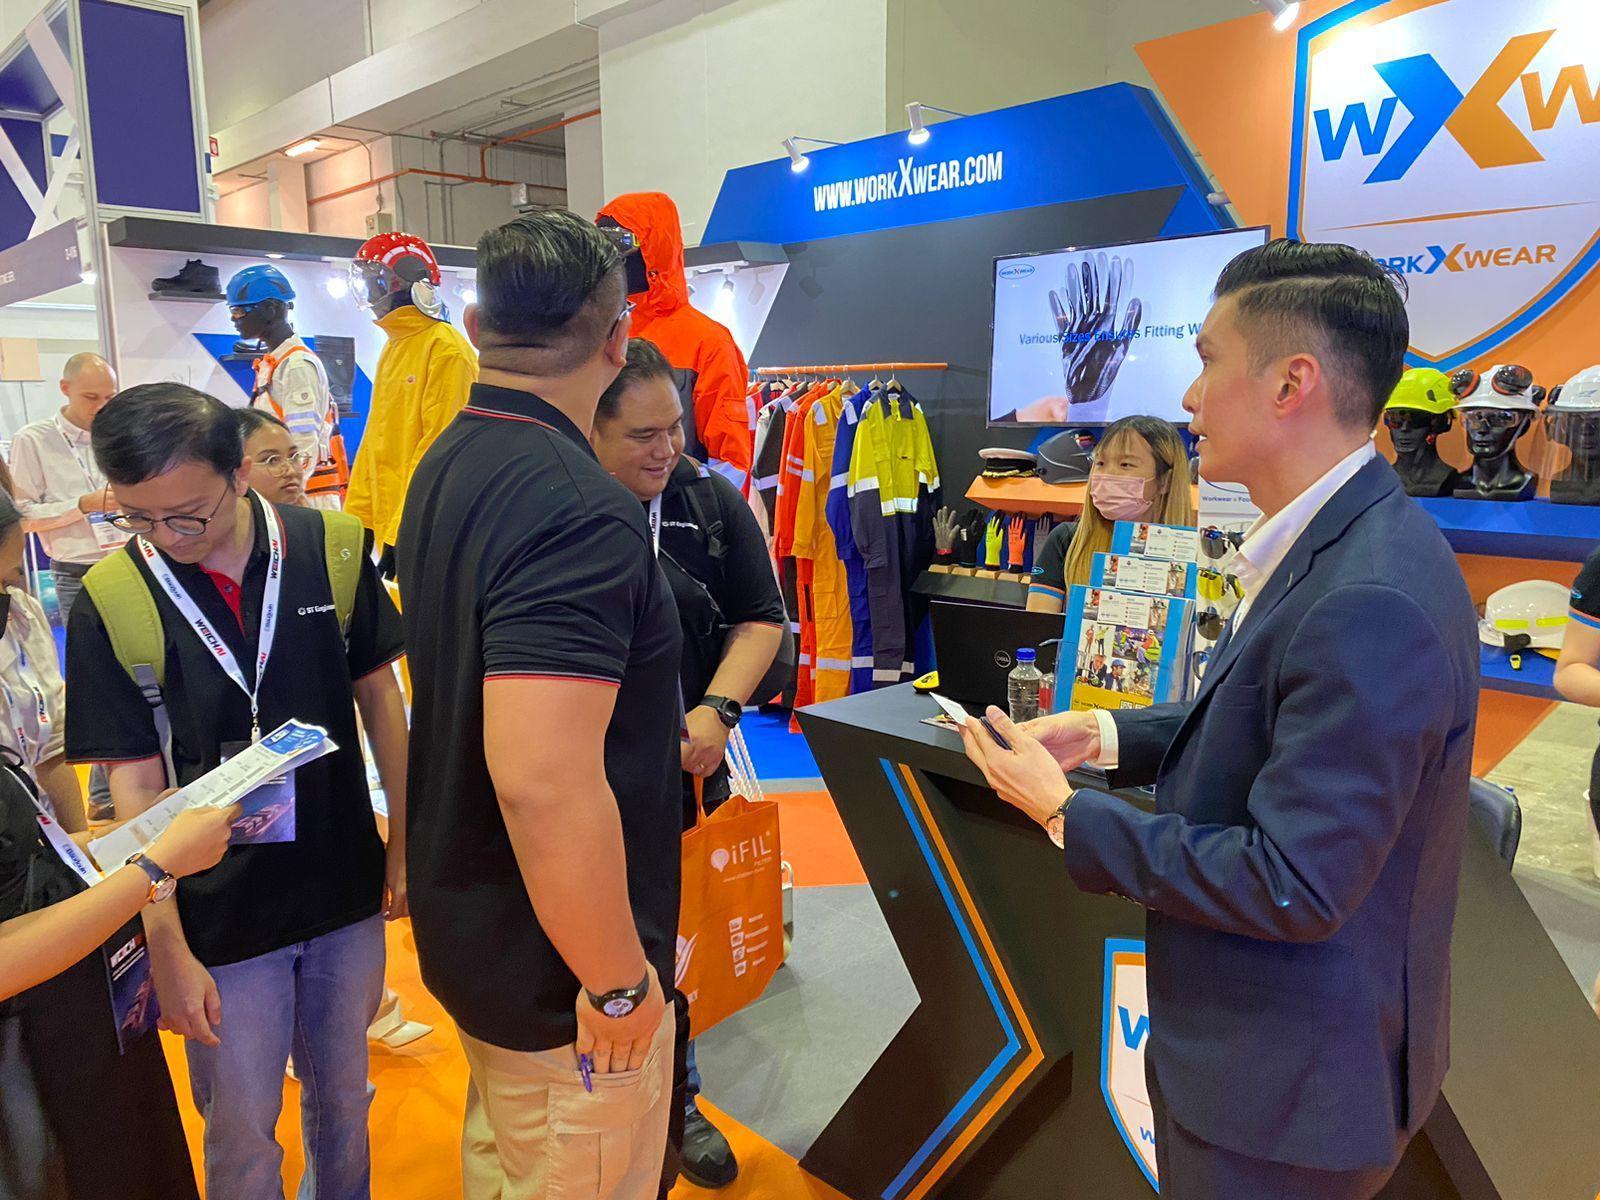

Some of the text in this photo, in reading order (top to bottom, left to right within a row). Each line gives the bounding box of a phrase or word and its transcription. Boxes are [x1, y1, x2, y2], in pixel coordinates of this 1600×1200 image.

[813, 151, 1003, 212] WWW.WORKXWEAR.COM
[1019, 333, 1059, 345] Various
[1061, 331, 1091, 344] Sizes
[1144, 325, 1184, 339] Fitting
[1188, 323, 1202, 335] W
[270, 539, 279, 579] WEICHAI
[306, 606, 314, 614] ST
[195, 618, 227, 656] WEICHAI
[731, 835, 772, 865] iFIL
